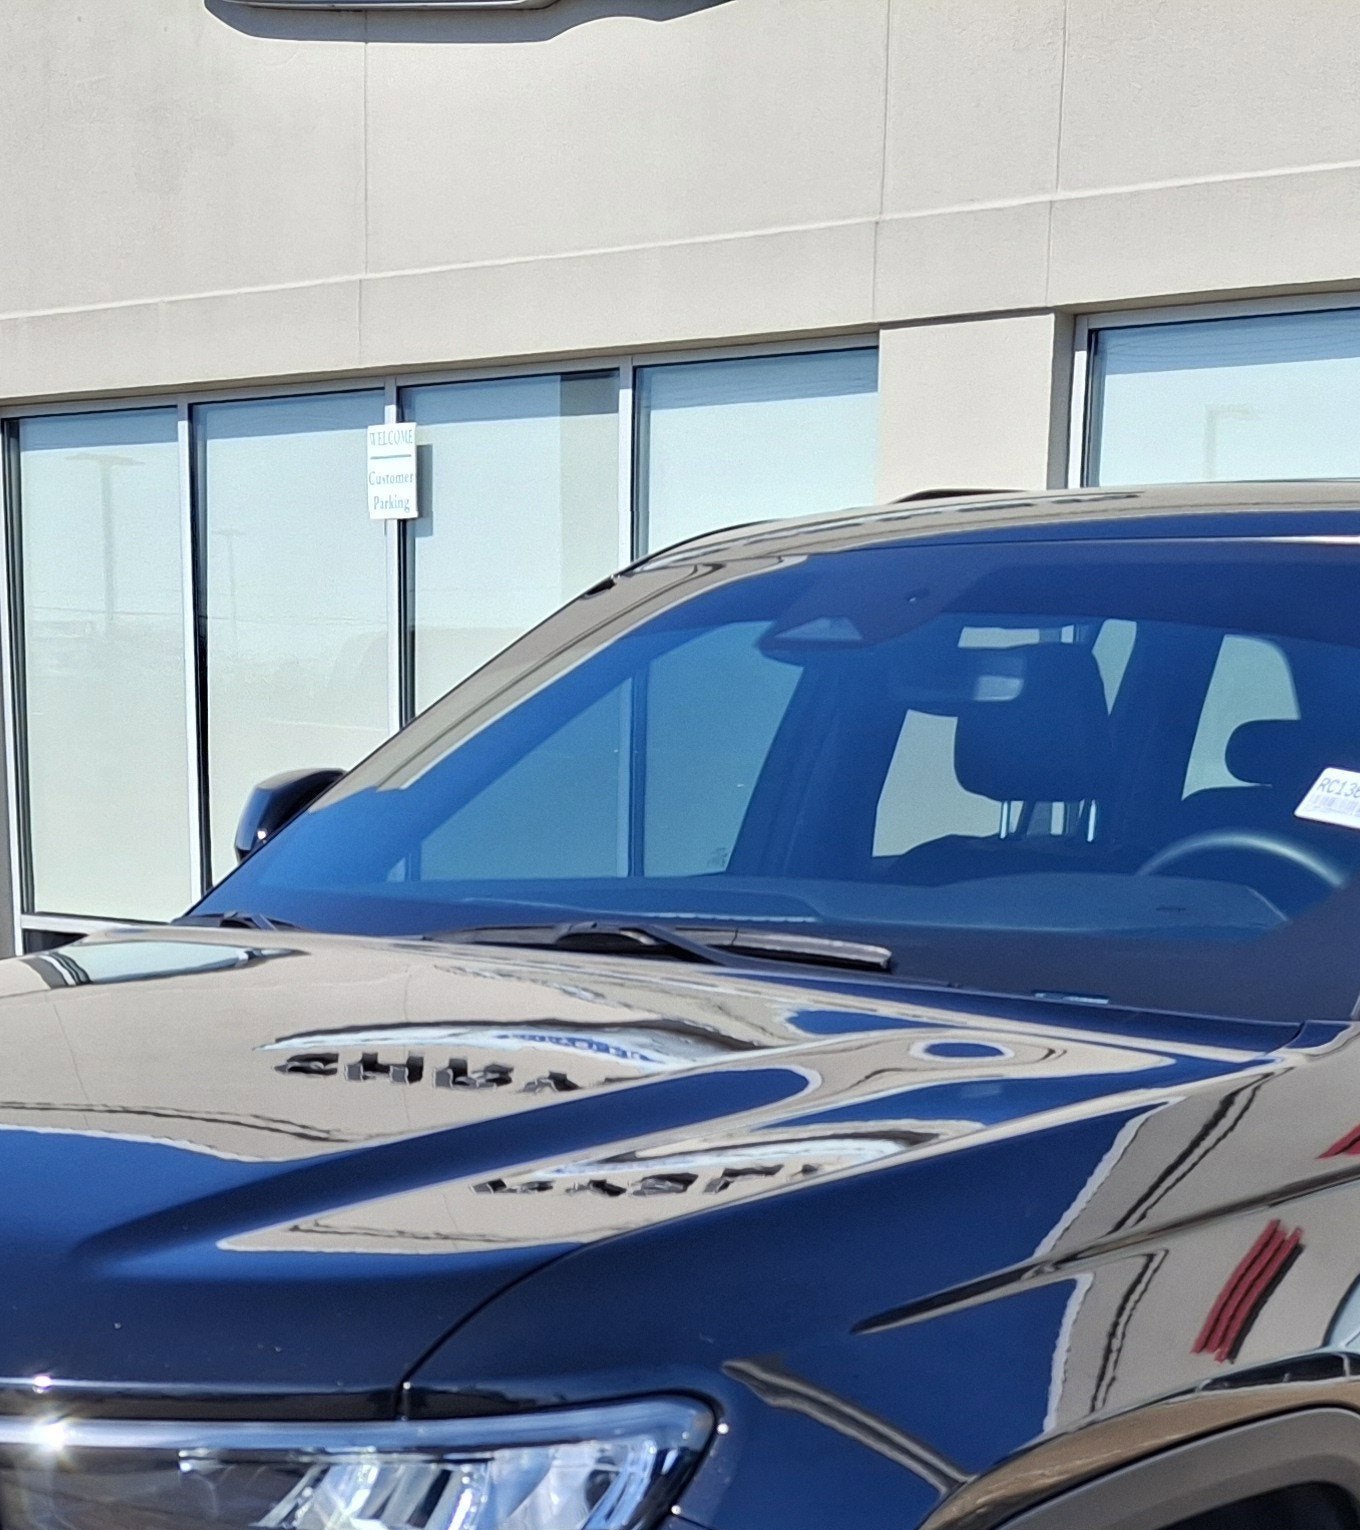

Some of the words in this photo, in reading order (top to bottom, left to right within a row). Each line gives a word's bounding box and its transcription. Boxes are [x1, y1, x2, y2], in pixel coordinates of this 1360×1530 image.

[370, 430, 413, 446] WELCOME
[369, 471, 413, 485] Customer
[374, 494, 410, 512] Parking
